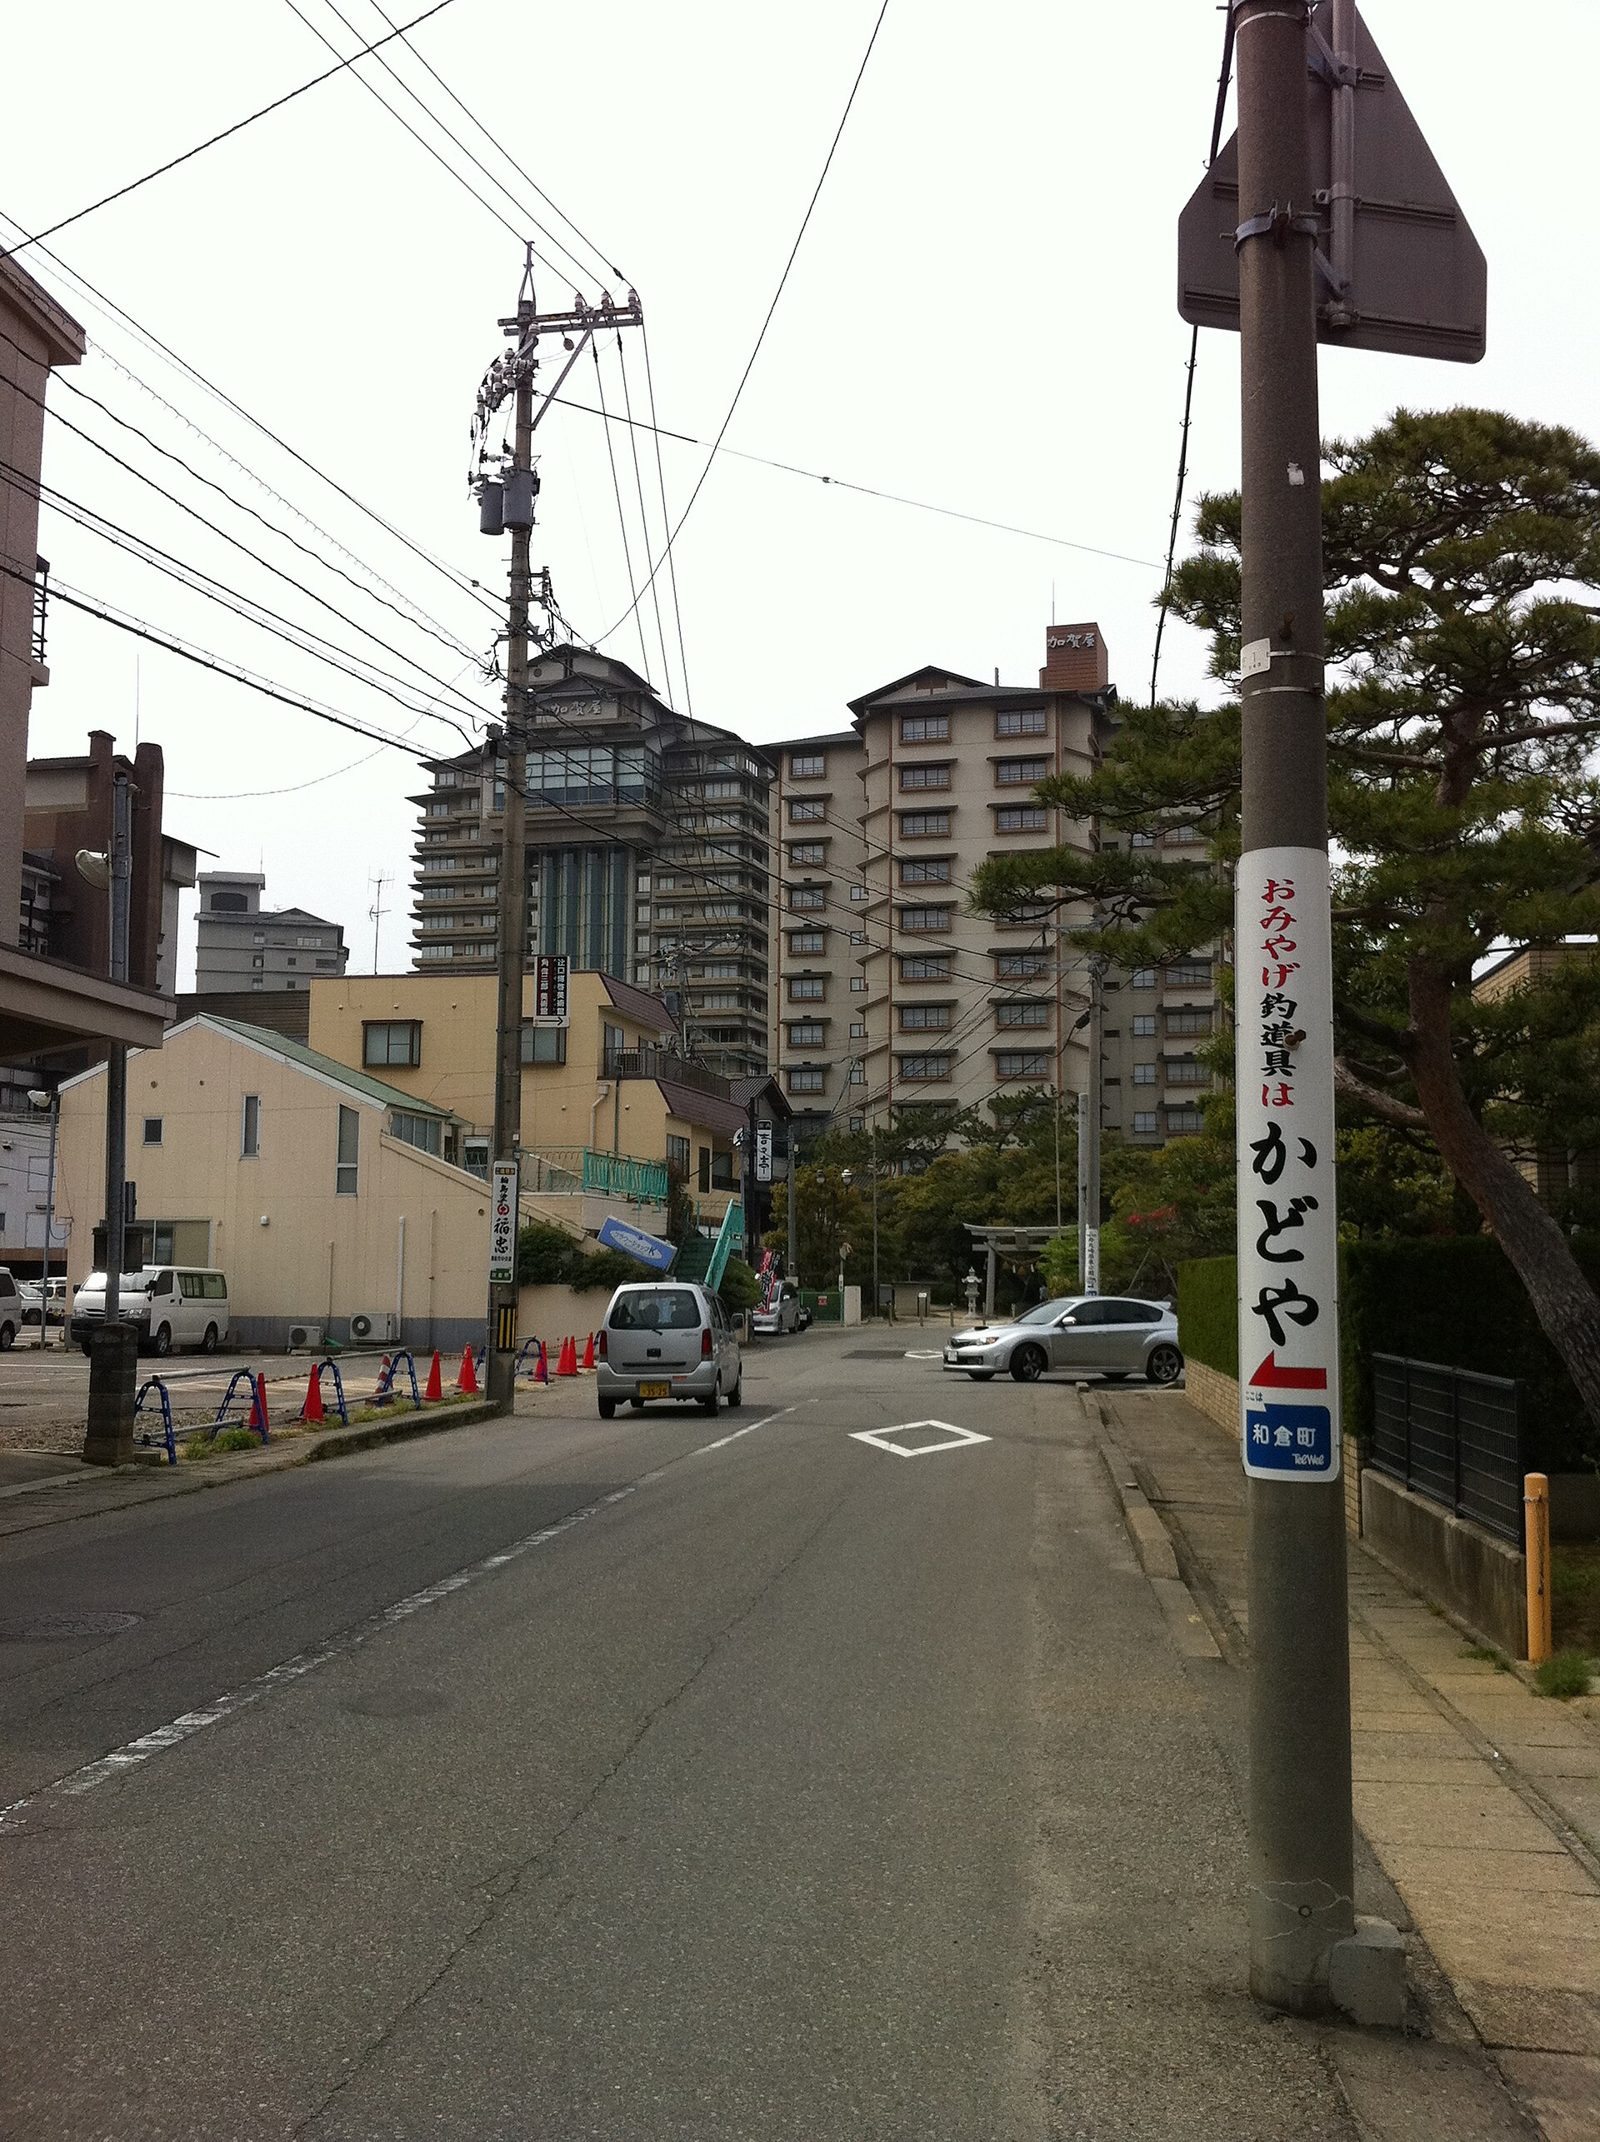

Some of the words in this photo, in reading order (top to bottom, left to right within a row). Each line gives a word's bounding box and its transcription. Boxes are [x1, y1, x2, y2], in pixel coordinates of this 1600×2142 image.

[1047, 632, 1095, 648] 加賀屋
[550, 700, 601, 716] 加賀屋
[1259, 878, 1300, 1107] おみやげ釣道具は
[493, 1217, 510, 1254] 稲忠
[1249, 1121, 1319, 1347] かどや
[1245, 1391, 1263, 1402] ここは
[1252, 1423, 1317, 1448] 和倉町
